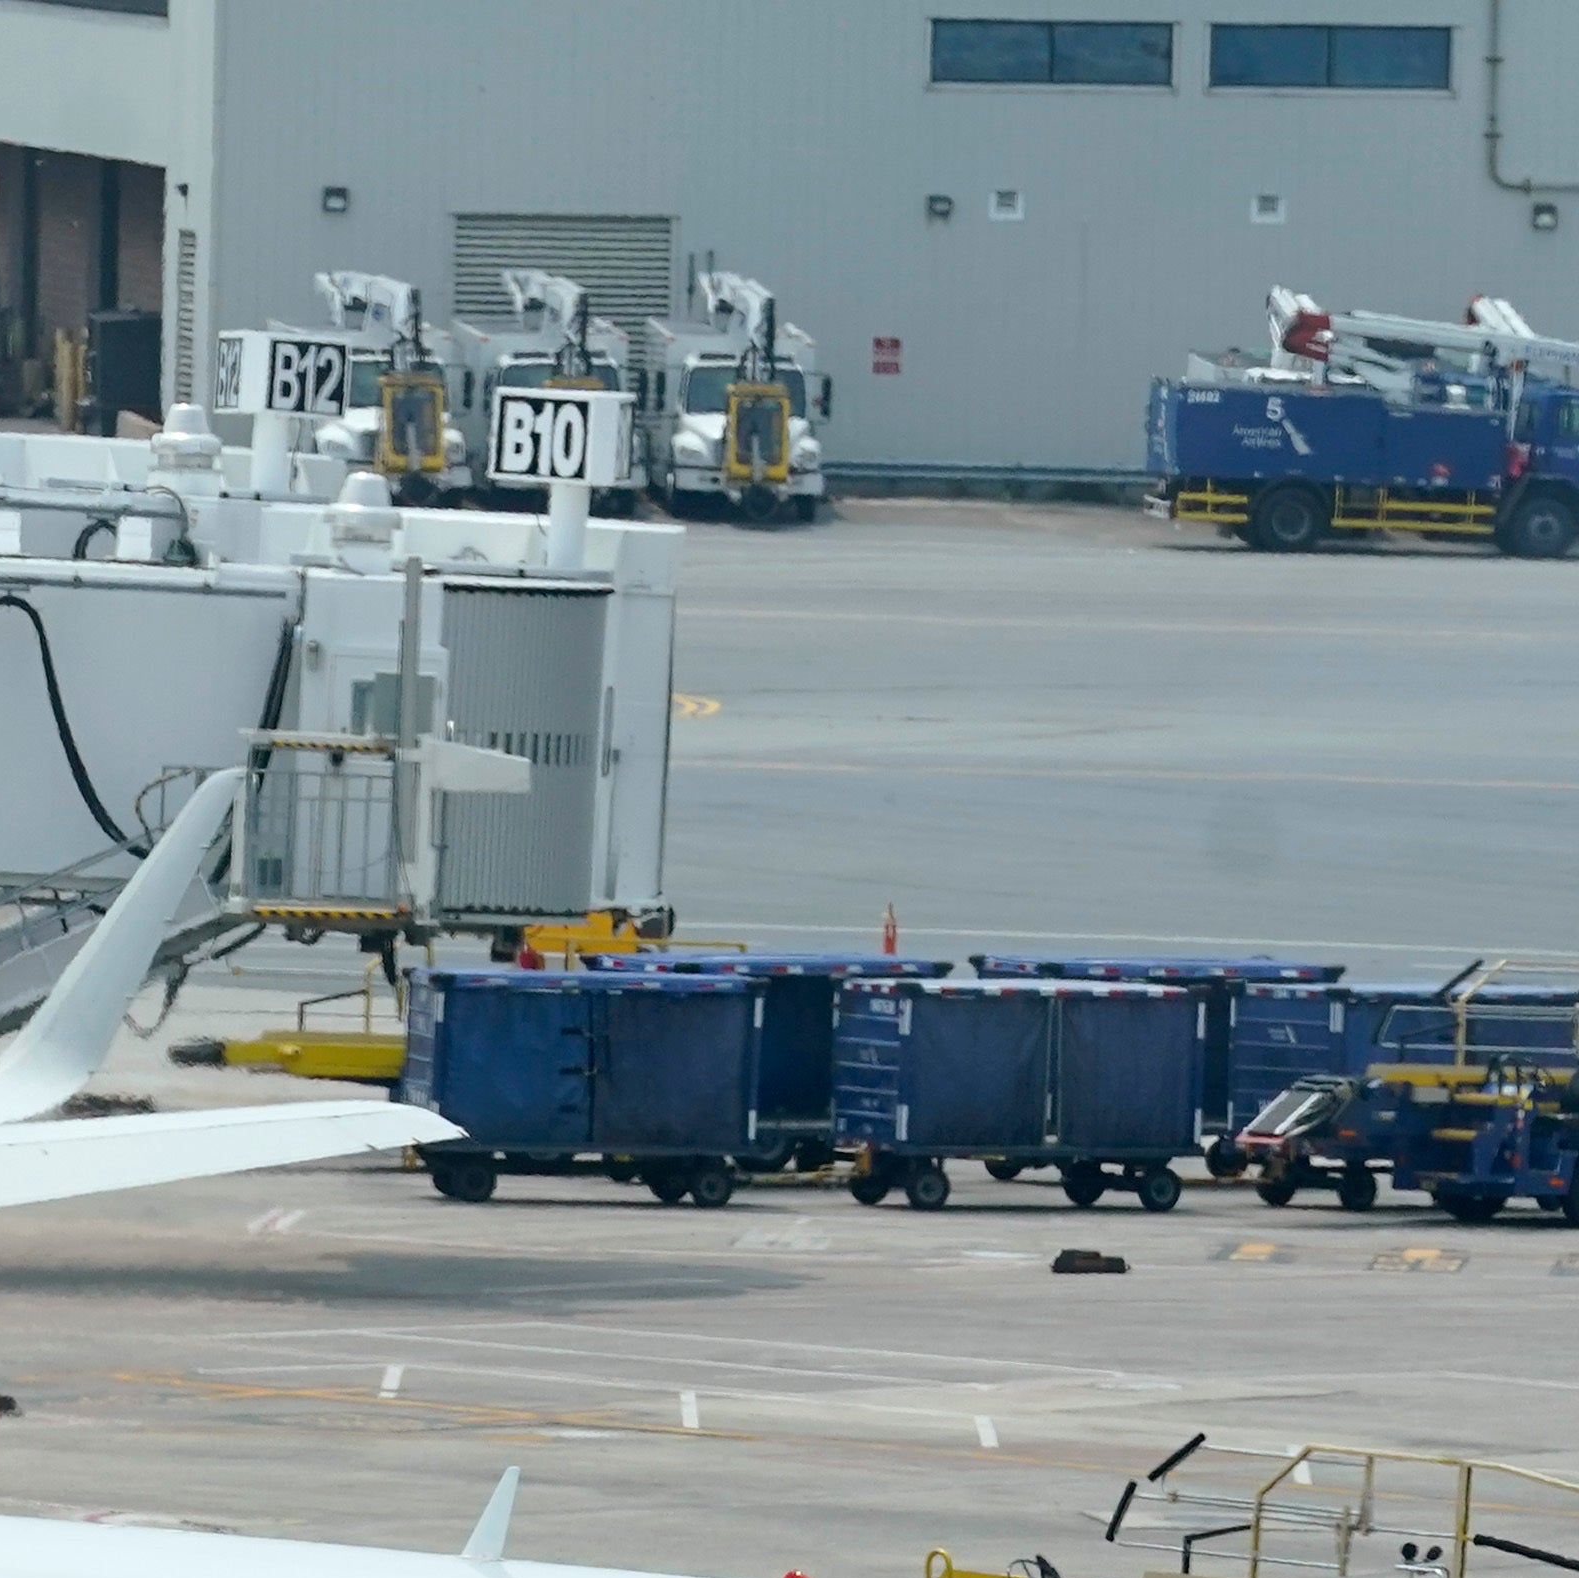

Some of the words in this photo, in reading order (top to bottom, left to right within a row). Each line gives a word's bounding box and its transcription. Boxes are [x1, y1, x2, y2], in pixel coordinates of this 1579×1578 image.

[271, 343, 343, 413] B12
[500, 400, 584, 478] B10
[1233, 424, 1282, 437] American
[1242, 436, 1281, 448] Airlines
